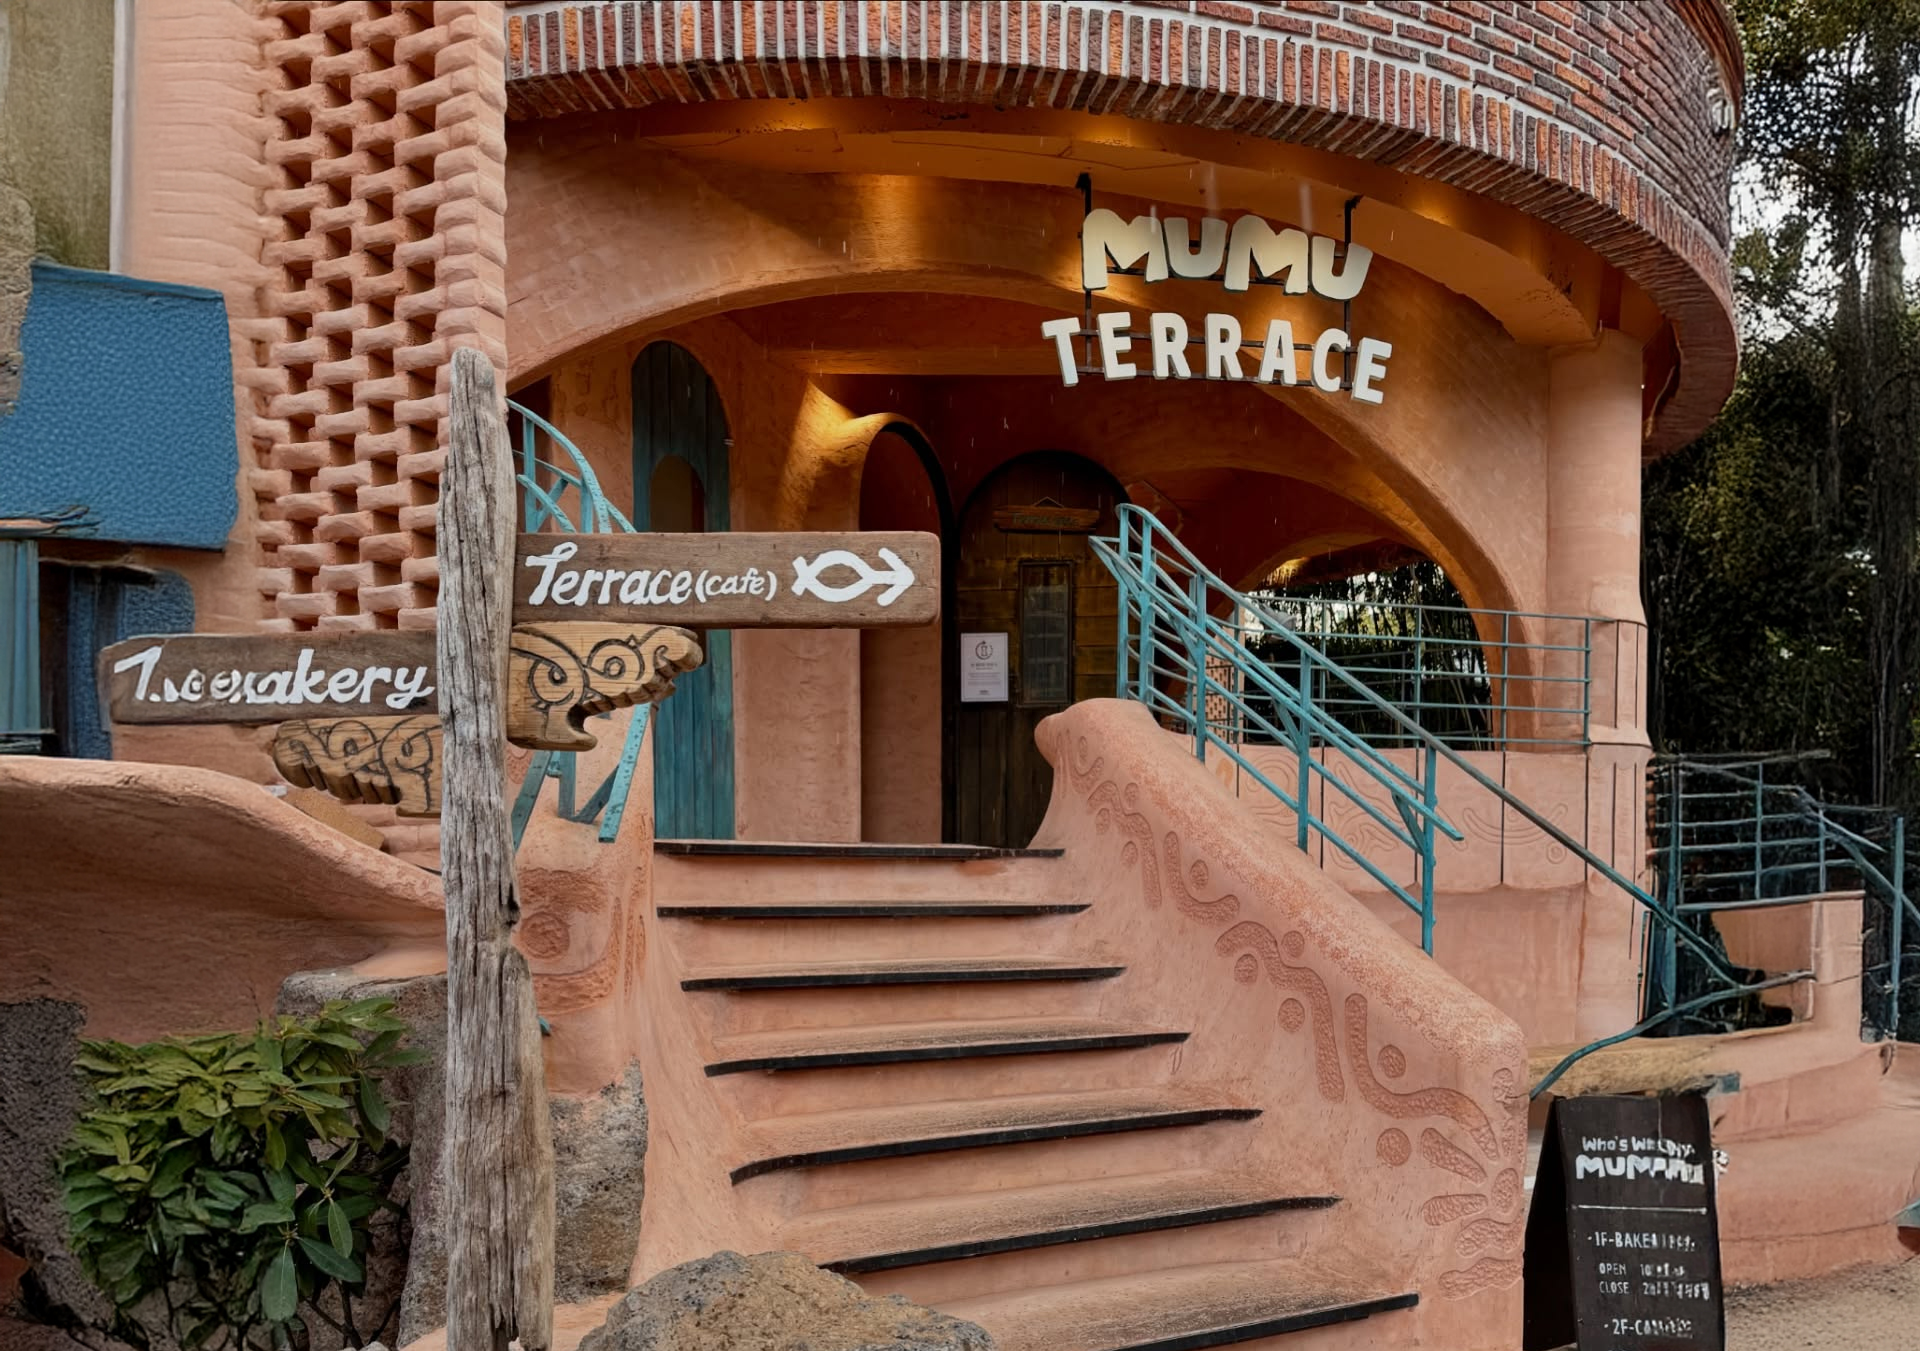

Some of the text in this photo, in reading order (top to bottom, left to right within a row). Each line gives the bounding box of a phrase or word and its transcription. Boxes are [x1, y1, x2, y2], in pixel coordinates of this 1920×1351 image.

[1082, 208, 1373, 300] MUMU
[1042, 311, 1392, 404] TERRACE
[525, 541, 692, 606] Terrace
[1600, 1263, 1626, 1275] OPEN
[1600, 1281, 1629, 1294] CLOSE
